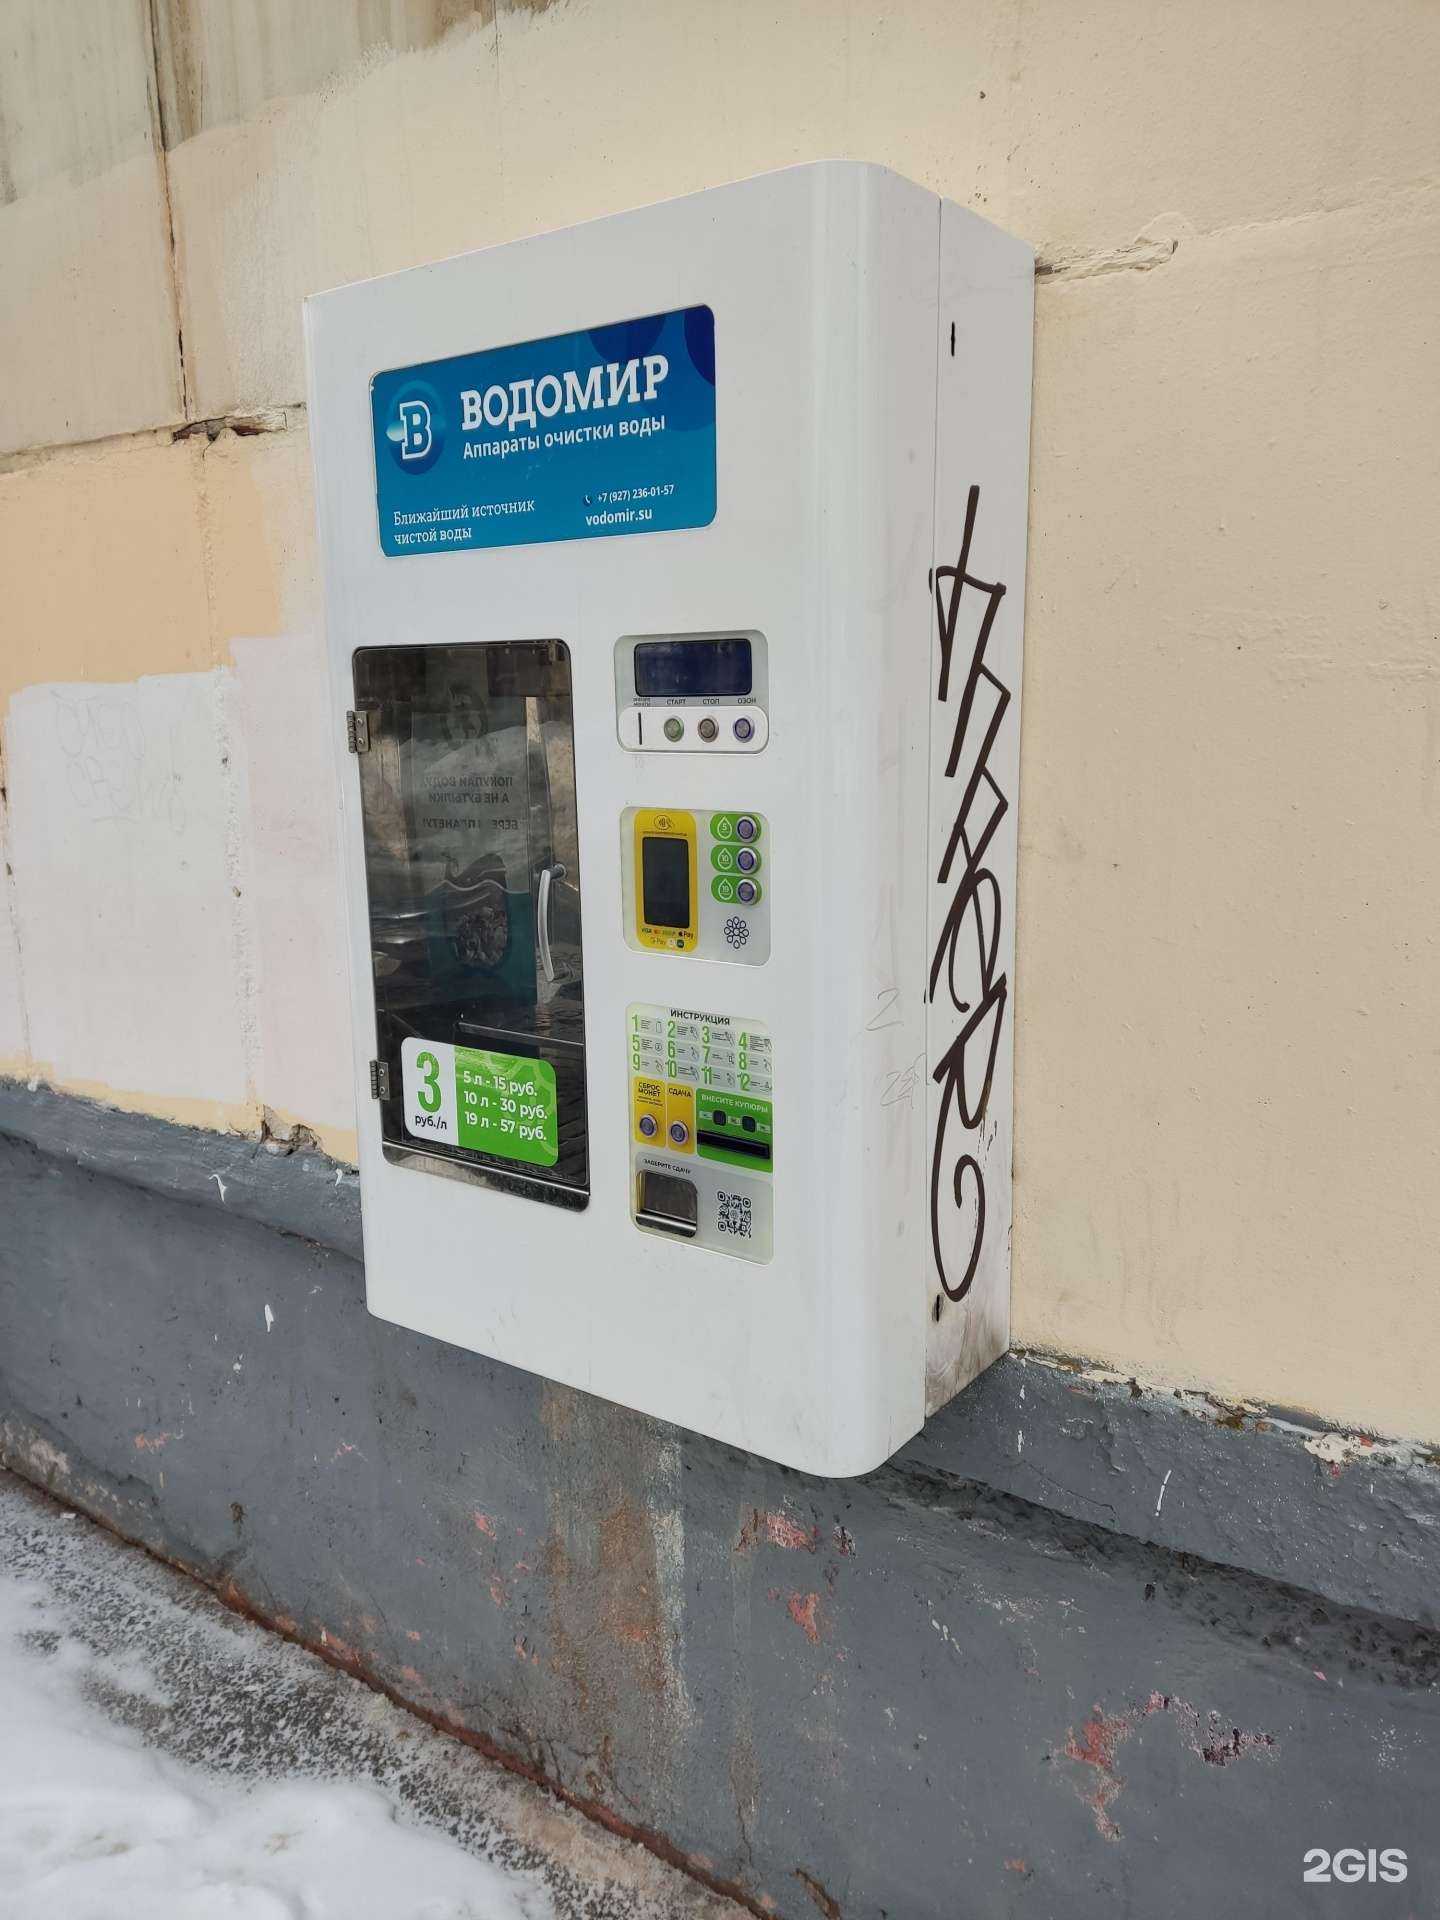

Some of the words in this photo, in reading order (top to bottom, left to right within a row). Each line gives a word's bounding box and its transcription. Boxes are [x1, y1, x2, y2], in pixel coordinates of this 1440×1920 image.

[460, 354, 669, 432] ВОДОМИР
[463, 433, 540, 460] Аппараты
[544, 421, 614, 448] очистки
[618, 415, 666, 438] воды
[597, 491, 607, 504] +7
[609, 489, 631, 504] (927)
[632, 484, 674, 499] 236-01-57
[393, 504, 469, 526] Ближайший
[471, 498, 535, 517] источник
[585, 507, 653, 526] vodomir.su
[394, 529, 437, 546] чистой
[439, 526, 472, 542] воды
[666, 698, 686, 706] СТАРТ
[702, 698, 720, 706] СТОП
[737, 697, 757, 705] ОЗОН
[632, 1014, 639, 1032] 1
[670, 1009, 730, 1025] ИНСТРУКЦИЯ
[667, 1020, 676, 1039] 2
[702, 1026, 711, 1044] 3
[632, 1034, 640, 1052] 5
[667, 1040, 676, 1059] 6
[738, 1032, 748, 1051] 4
[632, 1054, 640, 1071] 9
[702, 1046, 711, 1064] 7
[738, 1051, 747, 1070] 8
[665, 1060, 677, 1079] 10
[701, 1066, 712, 1085] 11
[416, 1051, 442, 1113] 3
[463, 1070, 472, 1083] 5
[474, 1076, 483, 1086] л
[493, 1075, 506, 1090] 15
[509, 1080, 538, 1097] руб.
[737, 1072, 750, 1091] 12
[669, 1087, 692, 1098] СДАЧА
[464, 1090, 477, 1105] 10
[480, 1097, 489, 1108] л
[500, 1098, 516, 1113] 30
[519, 1102, 548, 1120] руб.
[701, 1094, 734, 1107] ВНЕСИТЕ
[735, 1100, 769, 1113] КУПЮРЫ
[415, 1114, 448, 1130] руб./л
[464, 1111, 477, 1125] 19
[480, 1117, 490, 1128] л
[500, 1119, 516, 1133] 57
[519, 1124, 547, 1141] руб.
[643, 1158, 672, 1171] ЗАБЕРИТЕ
